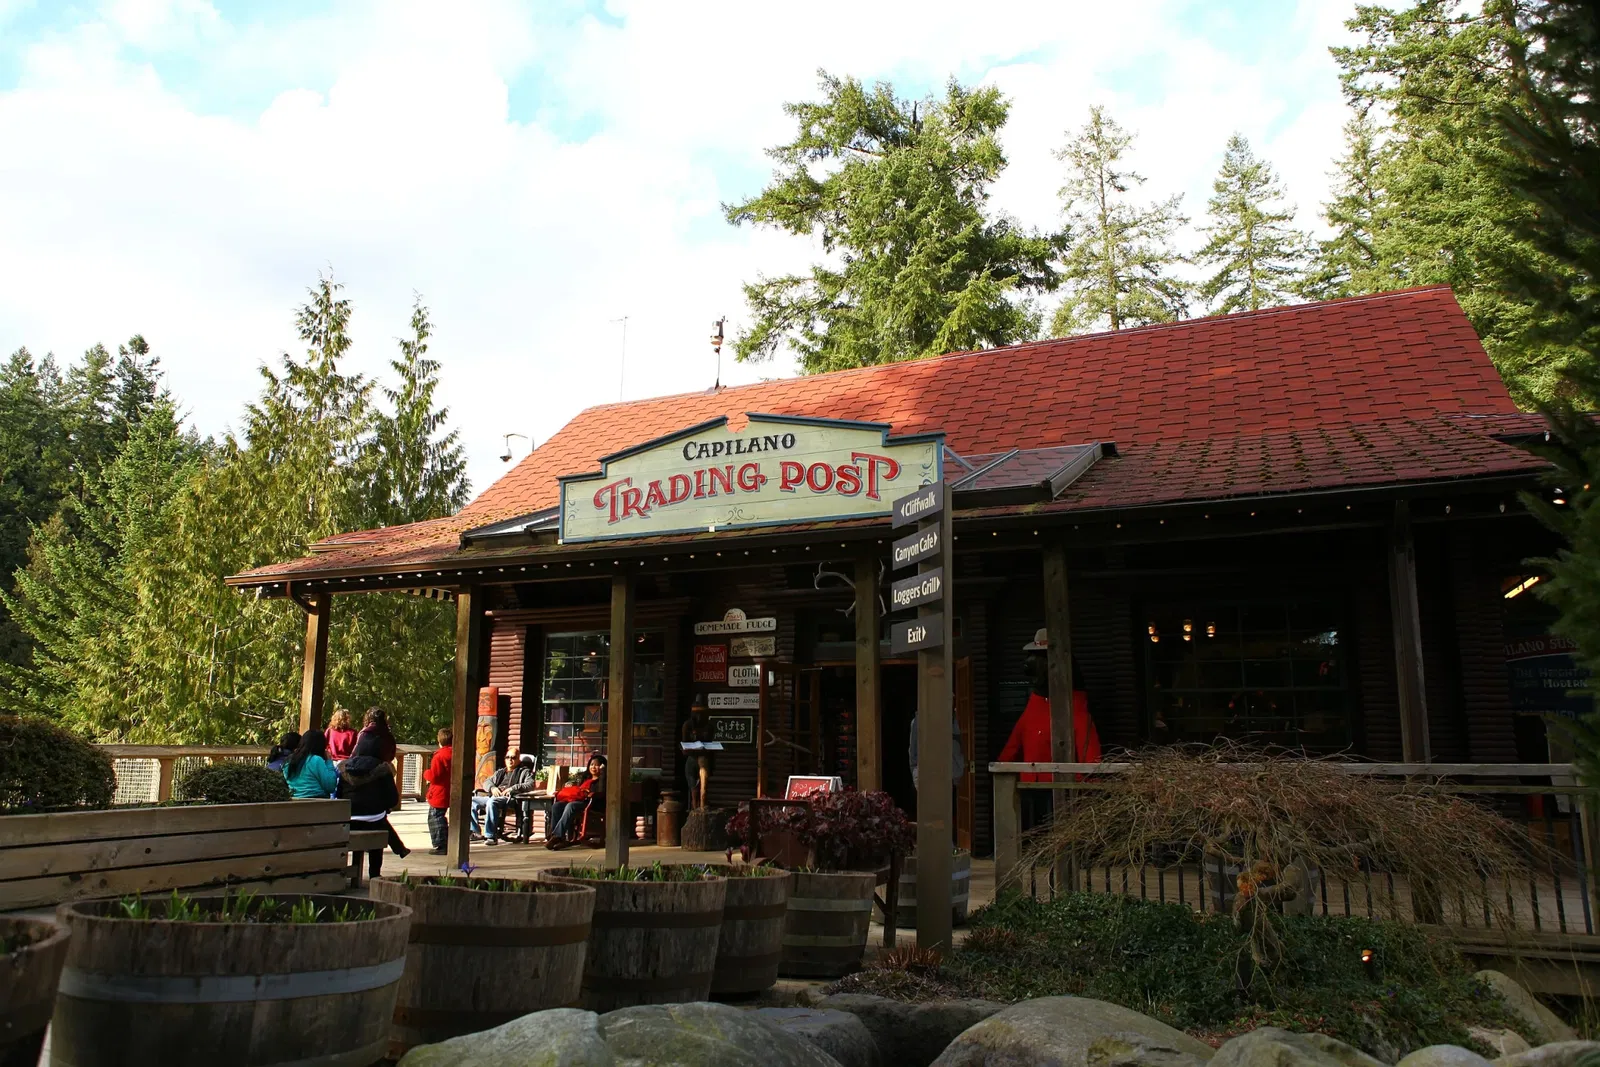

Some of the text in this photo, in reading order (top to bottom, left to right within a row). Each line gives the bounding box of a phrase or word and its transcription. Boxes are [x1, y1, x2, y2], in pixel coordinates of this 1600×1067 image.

[682, 433, 796, 461] CAPILANO
[593, 452, 902, 525] TRADING POST
[905, 491, 936, 517] Cliffwalk
[895, 533, 934, 562] Canyon Cafe
[894, 577, 937, 605] Loggers Grill
[696, 619, 774, 632] HOMEMADE FUDGE
[907, 626, 922, 643] Exit
[710, 697, 721, 706] WE
[723, 697, 740, 706] SHIP
[716, 720, 746, 732] Gifts
